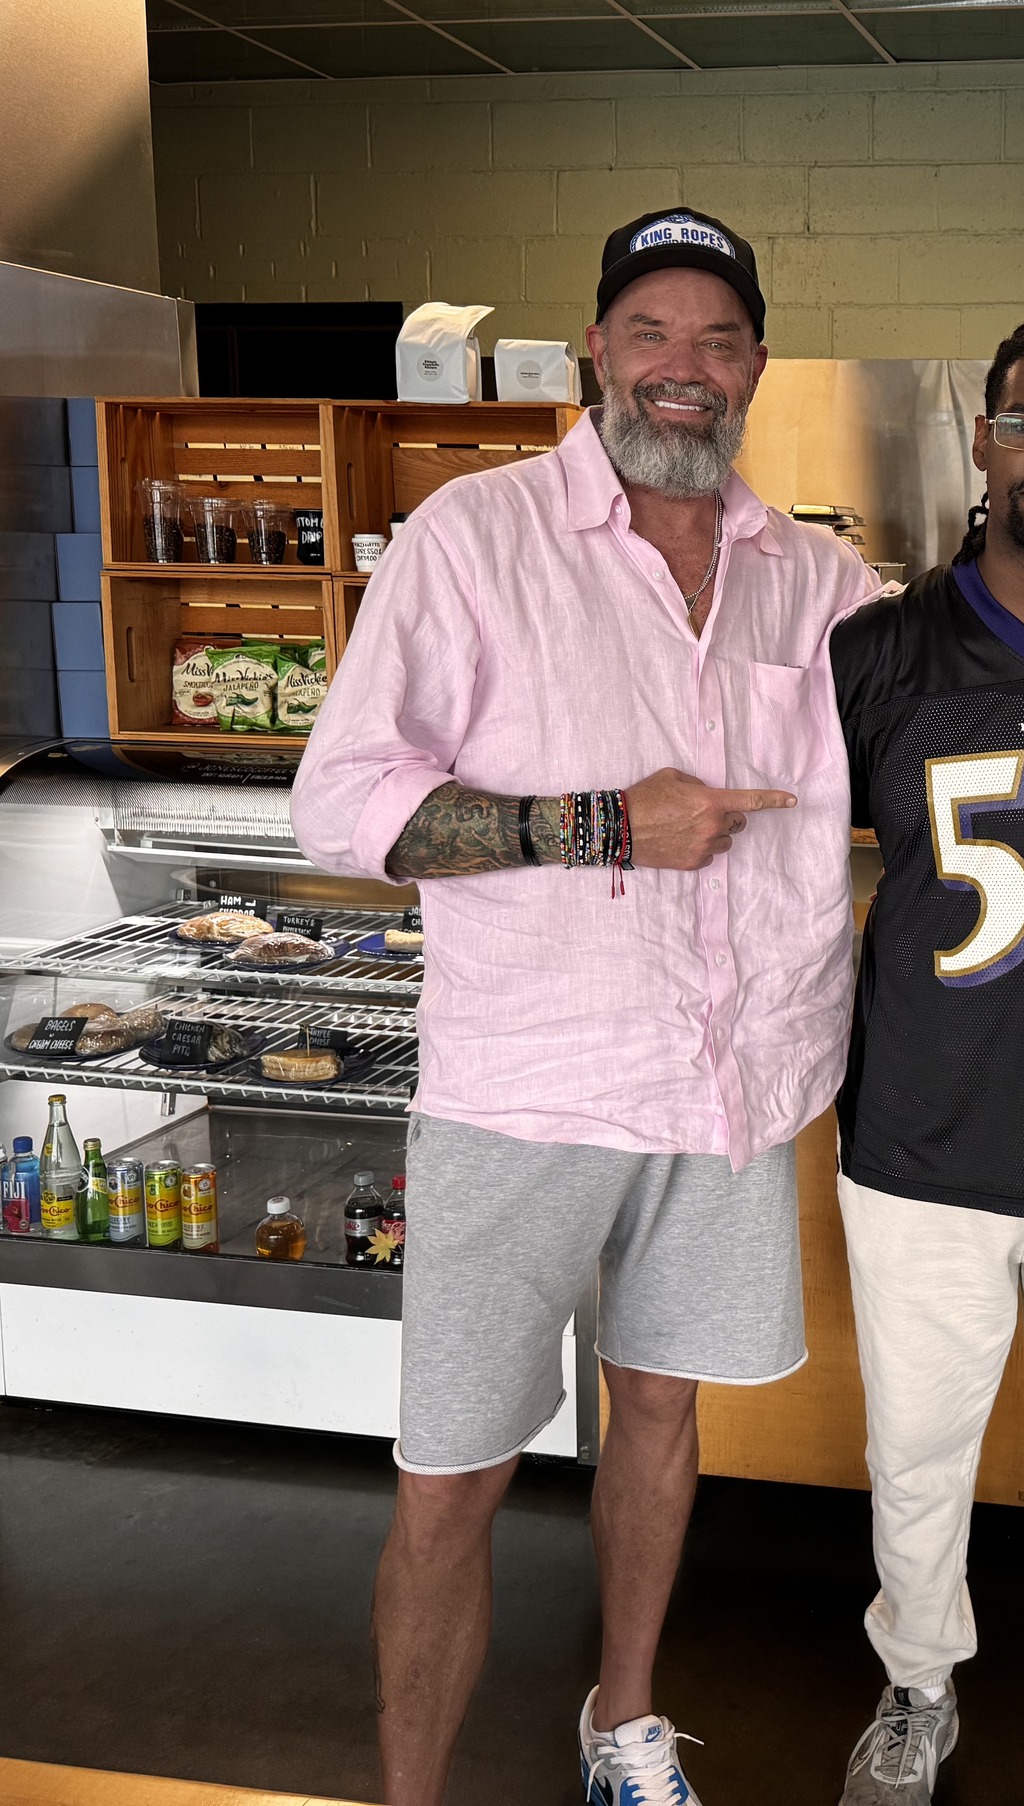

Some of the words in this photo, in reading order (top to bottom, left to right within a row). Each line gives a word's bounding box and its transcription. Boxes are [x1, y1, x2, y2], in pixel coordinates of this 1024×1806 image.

[640, 227, 672, 247] KING
[681, 228, 724, 249] ROPES
[220, 895, 242, 906] HAM
[44, 1020, 76, 1032] BAGELS
[174, 1022, 205, 1033] CHICKEN
[171, 1032, 201, 1043] CAESAR
[3, 1181, 26, 1199] FIJI
